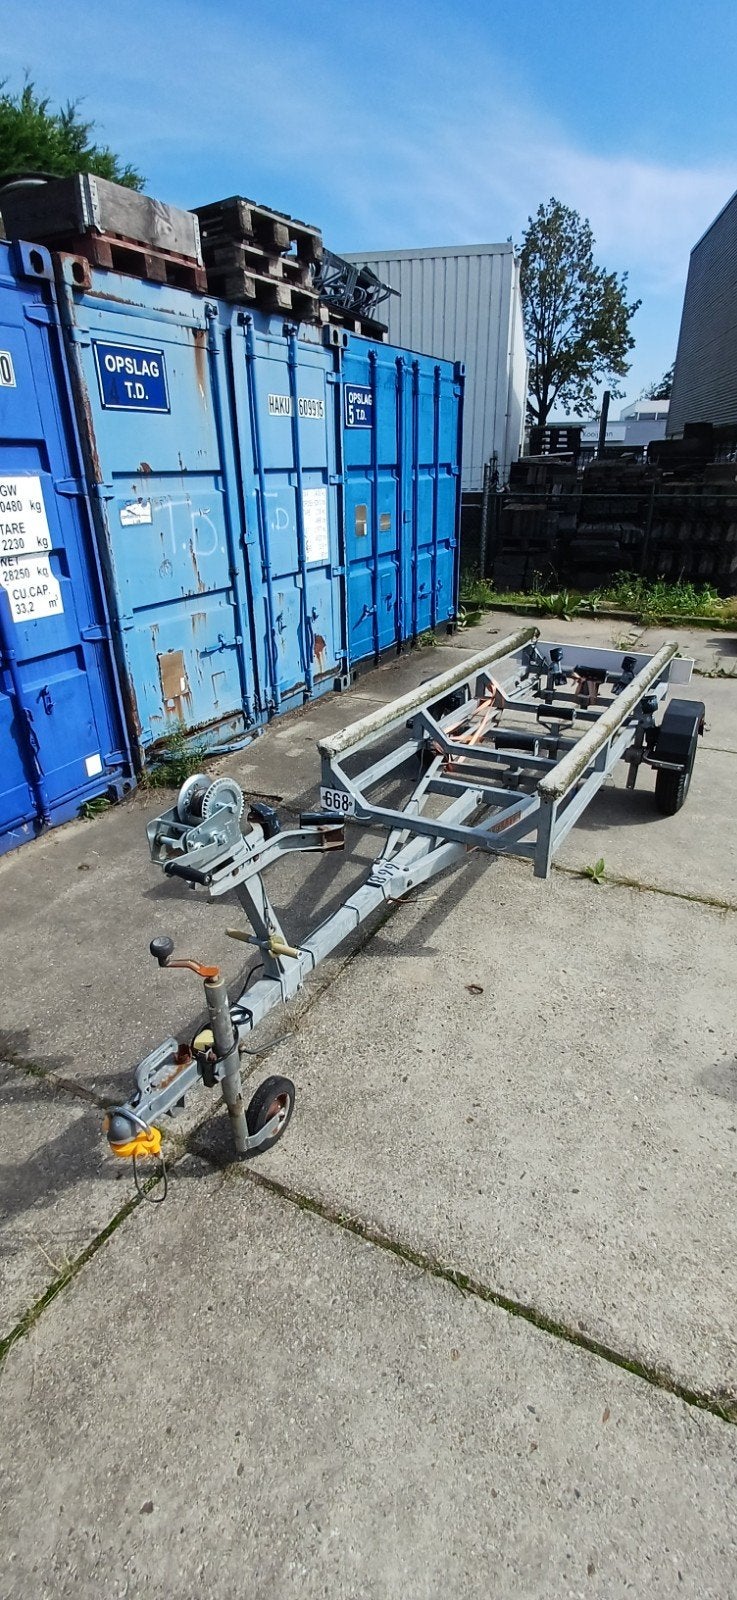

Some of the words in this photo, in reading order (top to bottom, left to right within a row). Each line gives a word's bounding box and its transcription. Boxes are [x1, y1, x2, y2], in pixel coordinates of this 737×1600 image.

[105, 354, 160, 378] OPSLAG
[124, 381, 149, 400] T.D.
[269, 395, 290, 414] HAKU
[348, 404, 354, 425] 5
[356, 408, 367, 421] T.D.
[29, 499, 42, 514] kg
[0, 522, 26, 535] TARE
[2, 537, 25, 551] 2230
[36, 535, 49, 549] kg
[3, 568, 30, 582] 28250
[325, 790, 349, 812] 668
